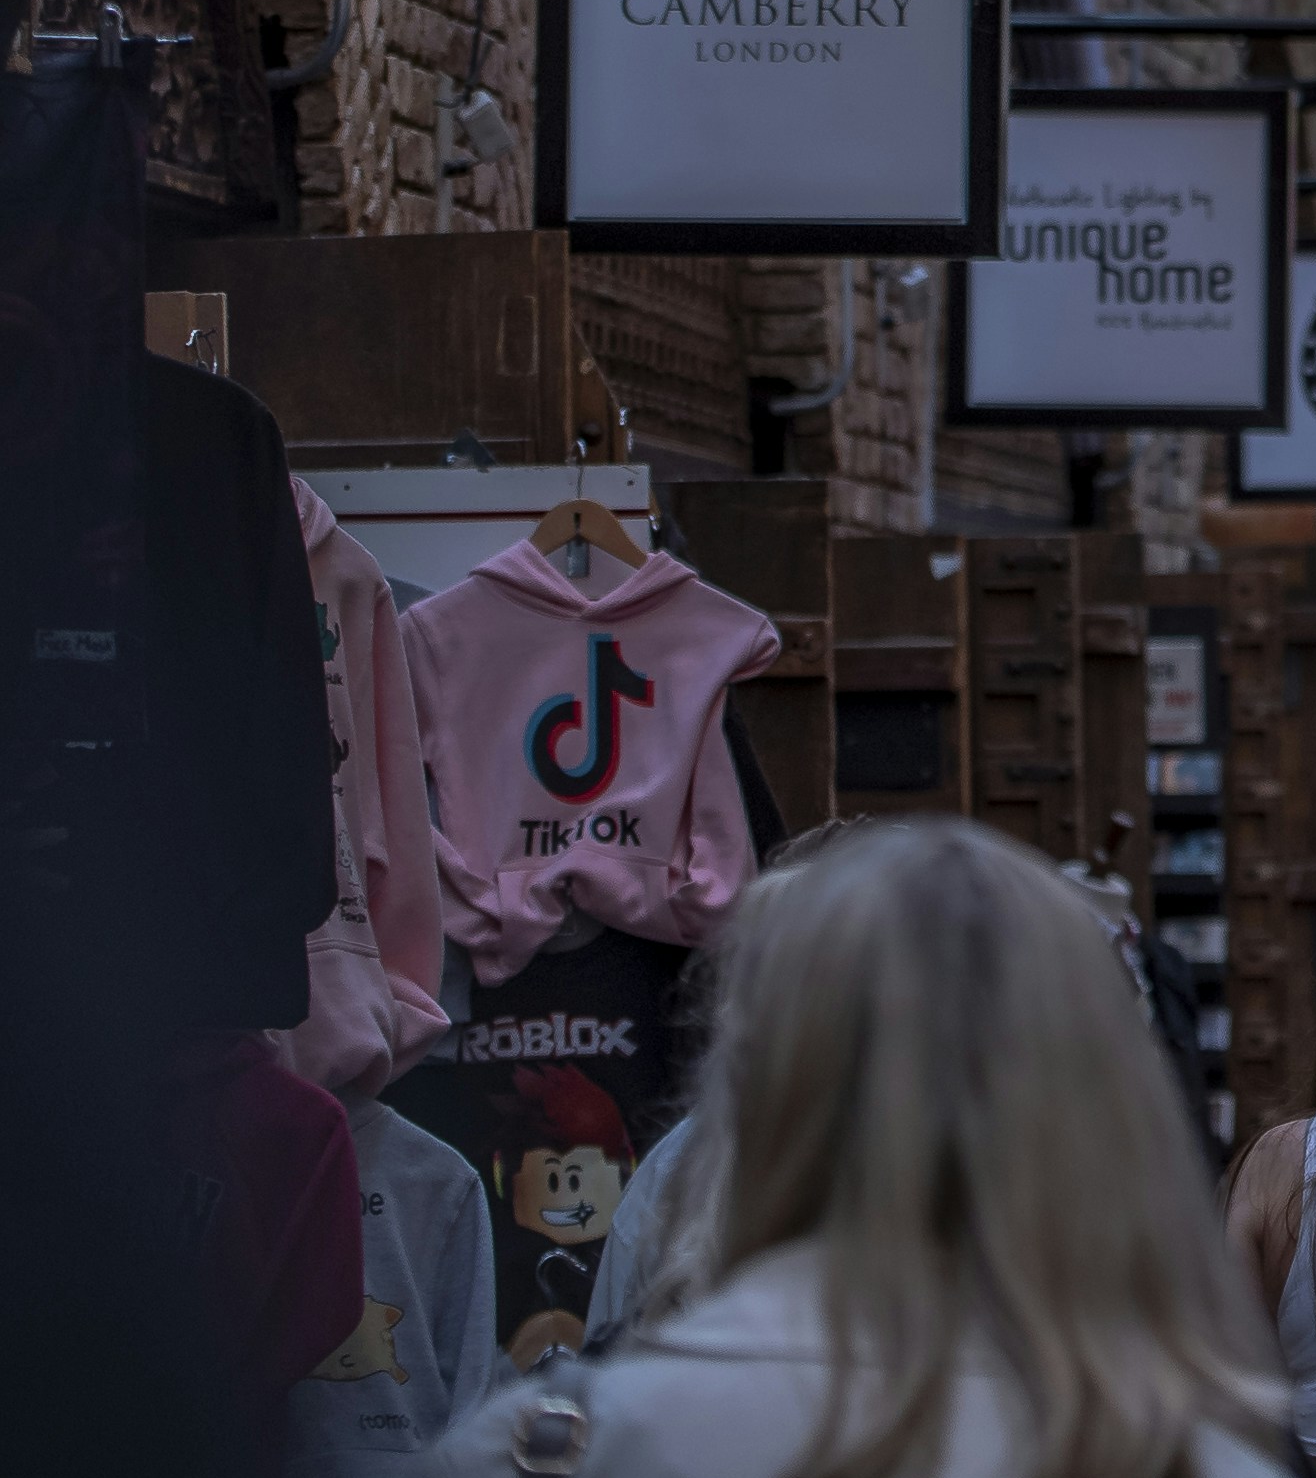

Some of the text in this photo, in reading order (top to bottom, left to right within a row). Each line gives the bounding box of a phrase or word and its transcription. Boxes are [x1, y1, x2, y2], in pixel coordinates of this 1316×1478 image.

[695, 40, 842, 64] LONDON
[1004, 220, 1167, 264] unique
[1098, 259, 1234, 304] home
